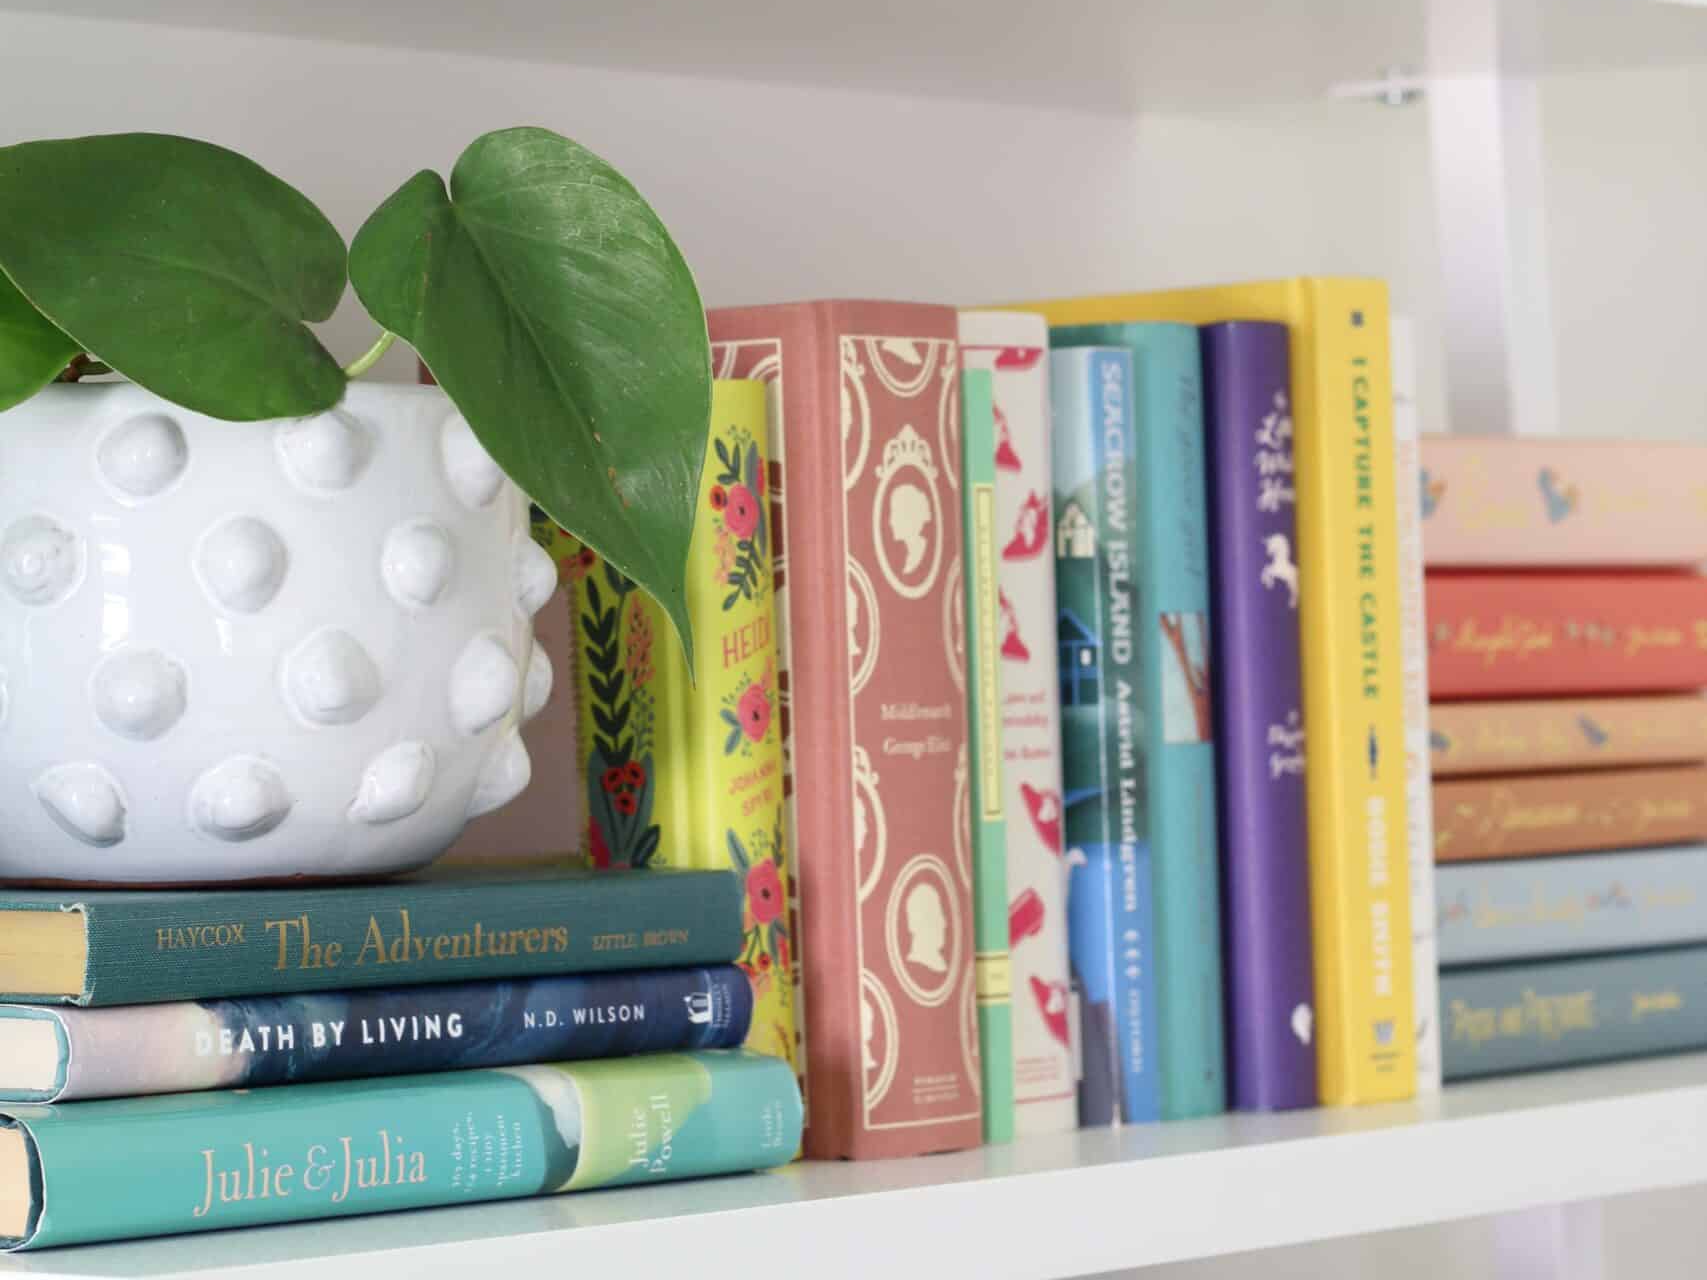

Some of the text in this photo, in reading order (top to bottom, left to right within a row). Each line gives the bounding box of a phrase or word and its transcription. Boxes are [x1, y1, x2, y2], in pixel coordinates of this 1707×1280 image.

[1352, 375, 1373, 510] CAPTURE
[1358, 524, 1375, 578] THE
[1107, 540, 1133, 666] ISLAND
[1359, 591, 1378, 699] CASTLE
[155, 924, 246, 950] HAYCOX
[265, 910, 568, 970] The Adventurers
[195, 1013, 463, 1057] DEATH BY LIVING
[523, 1003, 646, 1029] N.D. WILSON
[628, 1106, 648, 1169] Julie
[648, 1095, 673, 1174] Powell
[193, 1130, 428, 1217] Julie & Julia
